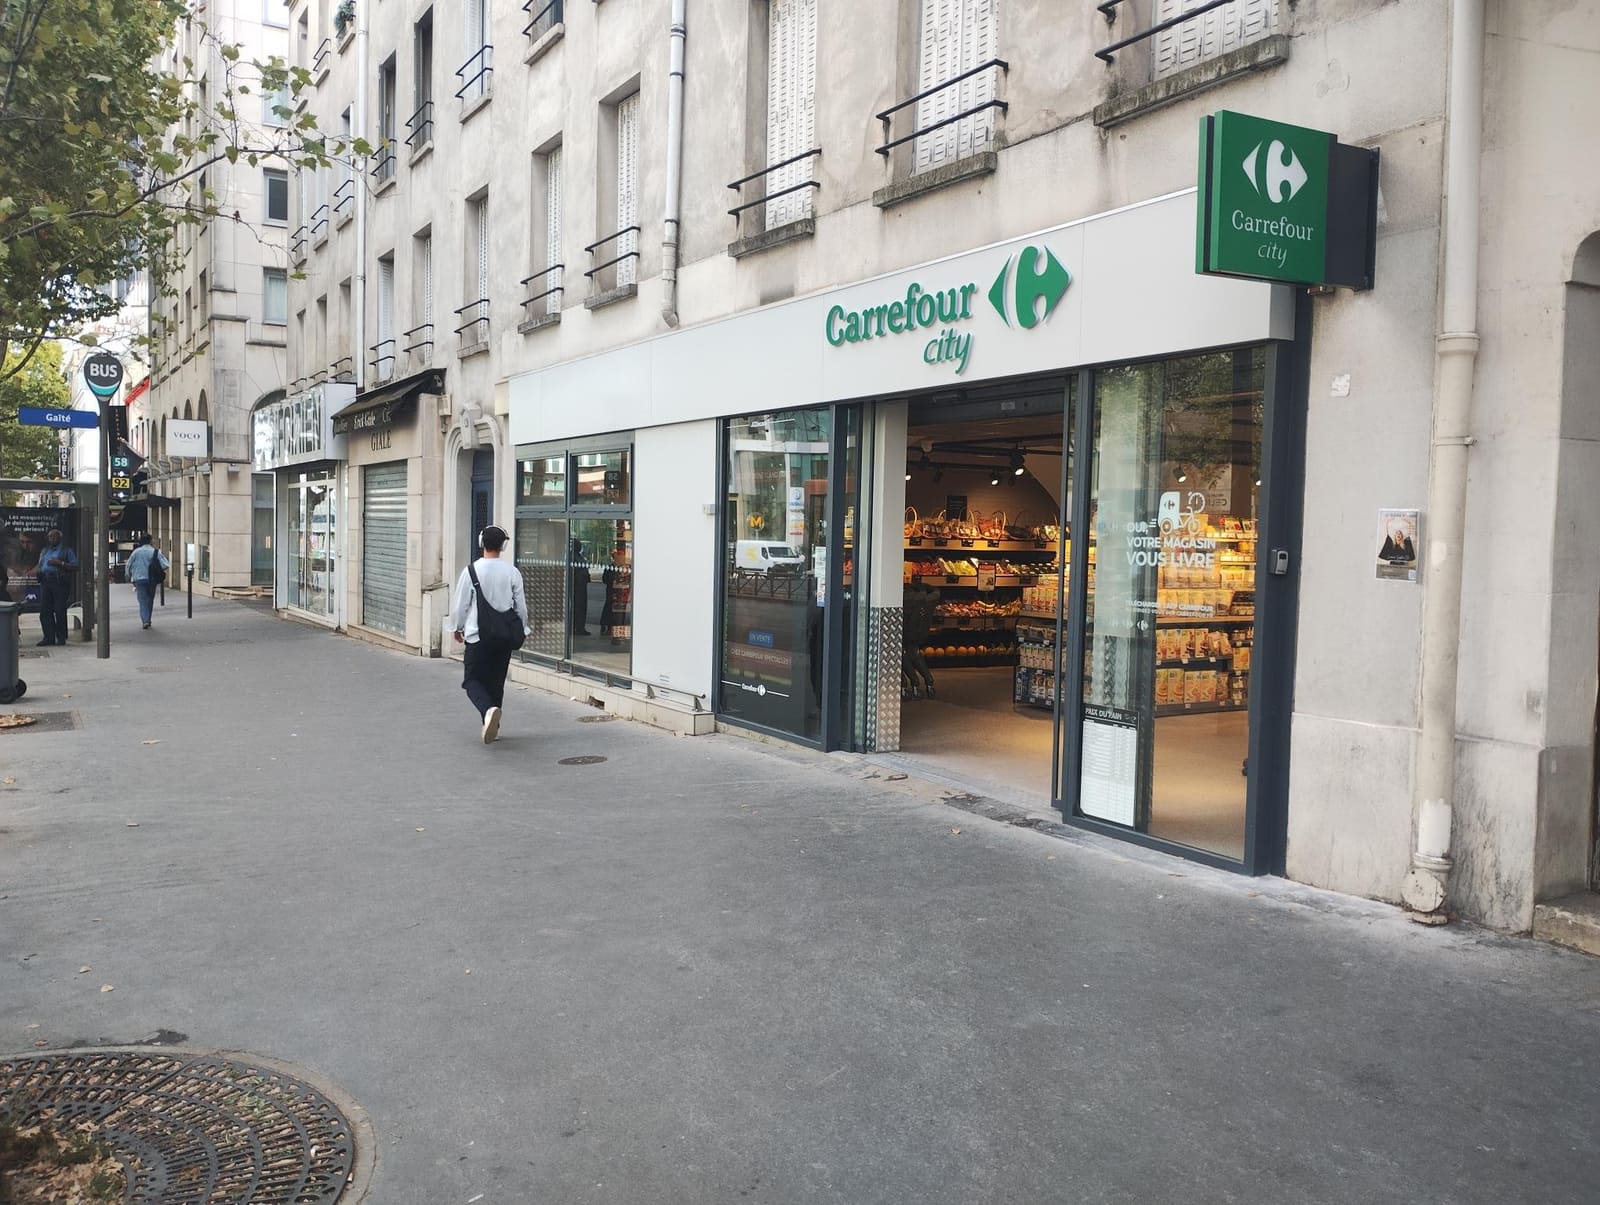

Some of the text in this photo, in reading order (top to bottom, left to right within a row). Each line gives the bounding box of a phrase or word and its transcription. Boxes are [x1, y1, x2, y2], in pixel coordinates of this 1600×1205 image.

[1231, 209, 1314, 241] Carrefour
[1257, 242, 1288, 269] city
[825, 282, 977, 347] Carrefour
[923, 327, 972, 375] city
[90, 363, 117, 378] BUS
[114, 457, 128, 467] 58
[114, 478, 128, 488] 92
[1126, 536, 1216, 549] VOTRE MAGASIN
[1126, 551, 1214, 568] VOUS LIVRE
